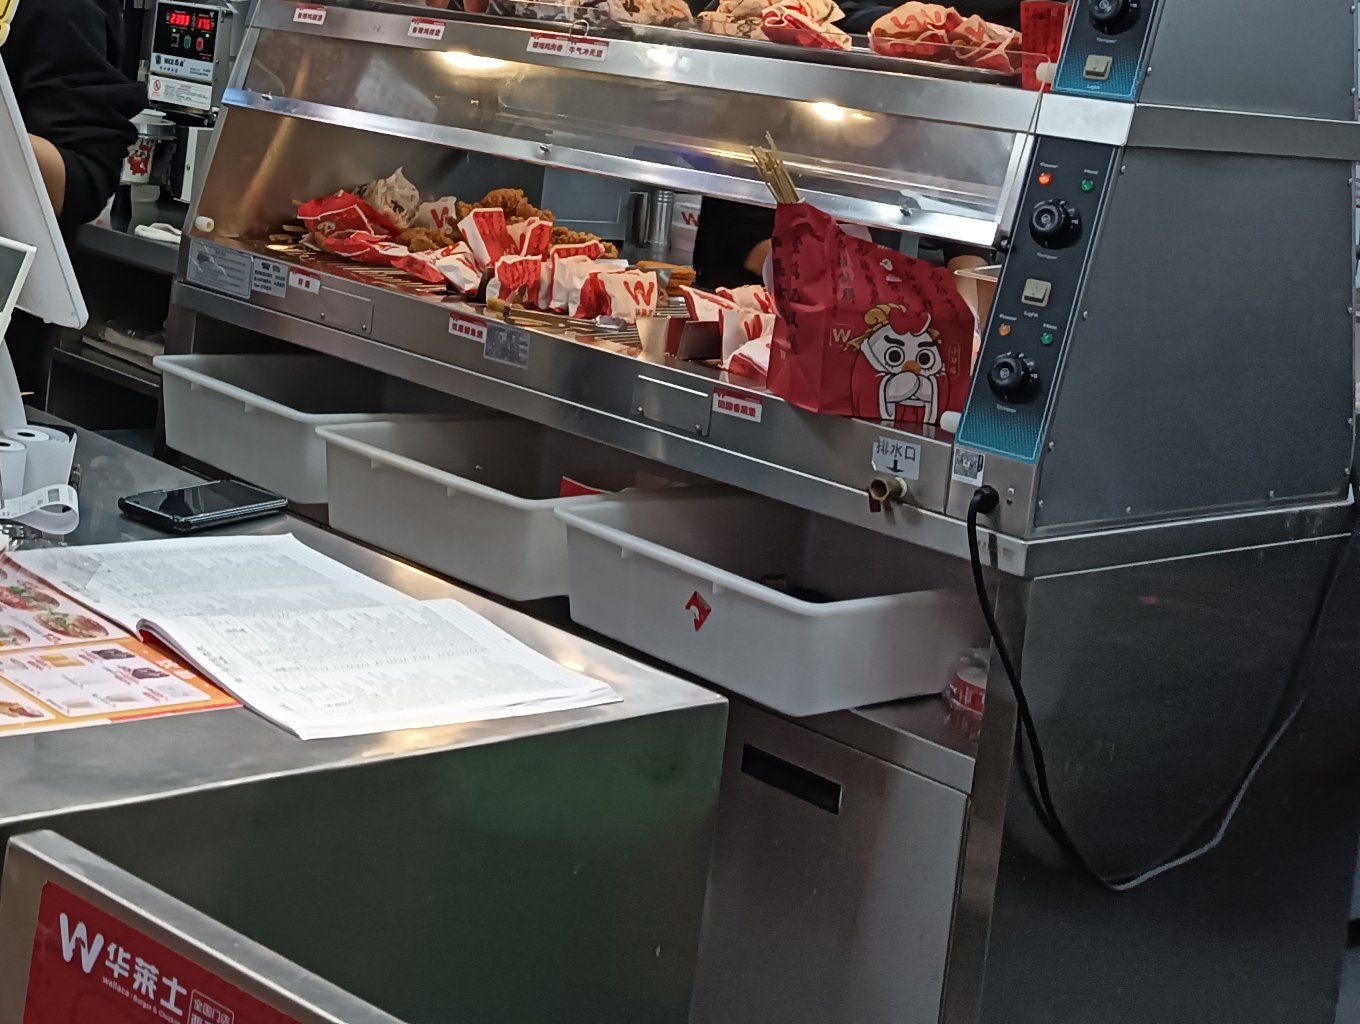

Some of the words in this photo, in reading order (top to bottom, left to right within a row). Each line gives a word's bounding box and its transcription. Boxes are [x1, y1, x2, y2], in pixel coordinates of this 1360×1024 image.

[877, 438, 917, 463] 排水口
[101, 976, 131, 997] Wallace
[104, 940, 188, 1018] 华莱士
